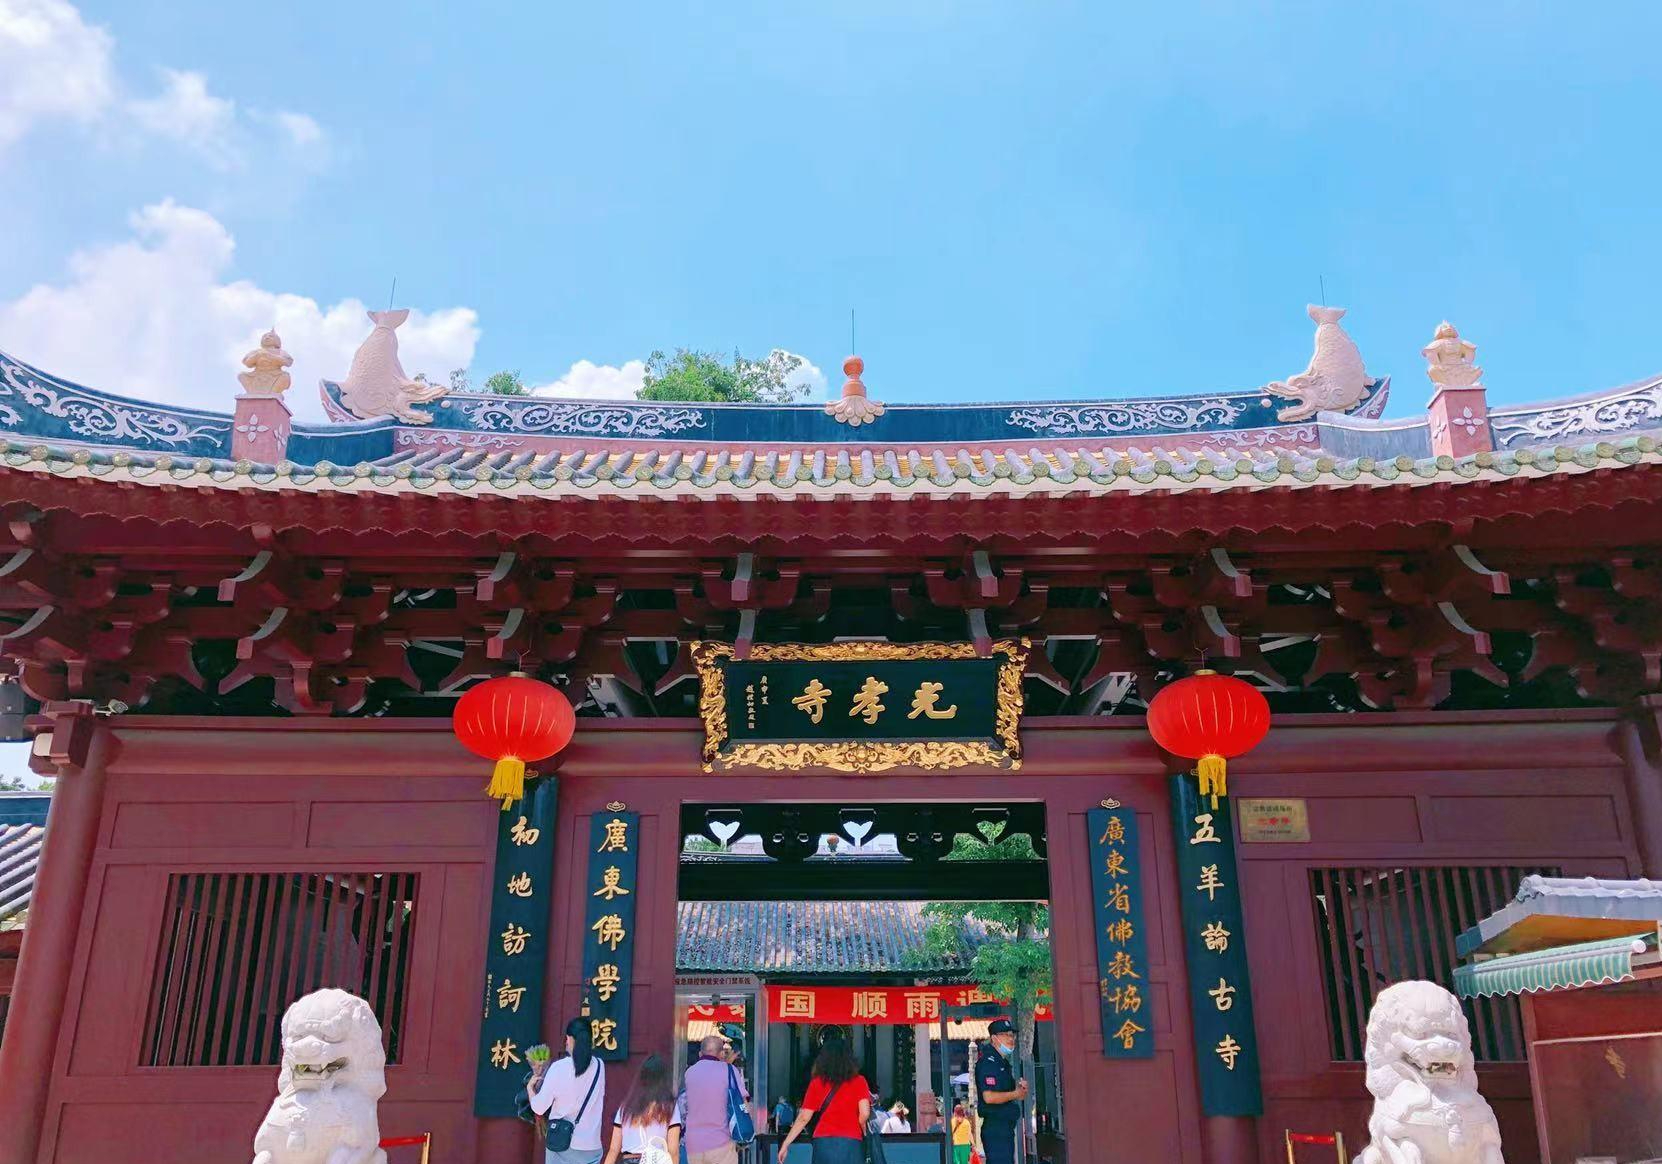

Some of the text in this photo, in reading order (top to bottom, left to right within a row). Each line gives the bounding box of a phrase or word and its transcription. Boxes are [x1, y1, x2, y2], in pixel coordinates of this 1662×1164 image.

[791, 676, 958, 725] 光孝寺
[491, 816, 540, 1070] 初地訪訶林
[591, 818, 630, 1051] 廣東佛學院
[1099, 816, 1146, 1049] 廣東省佛教協會
[1190, 813, 1242, 1071] 五羊論古寺
